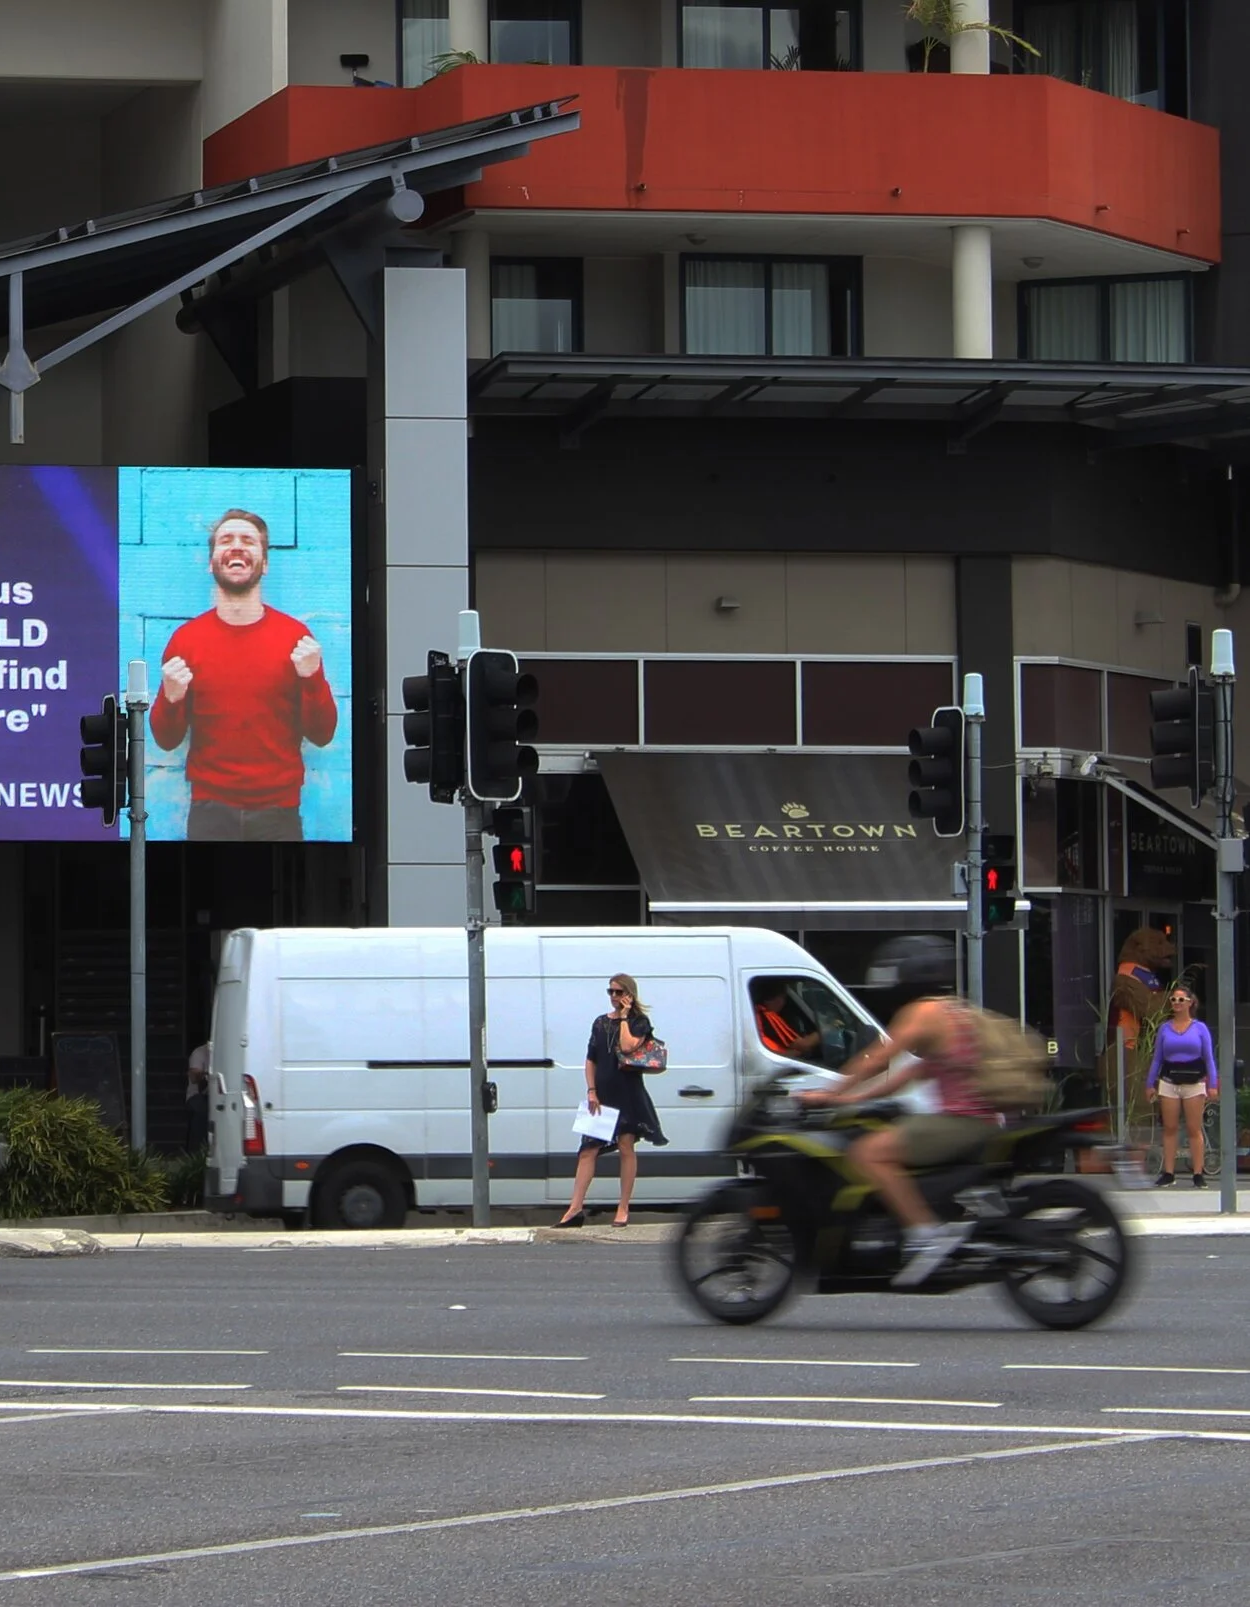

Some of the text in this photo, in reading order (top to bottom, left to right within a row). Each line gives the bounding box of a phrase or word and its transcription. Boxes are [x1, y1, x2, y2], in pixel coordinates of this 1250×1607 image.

[695, 824, 918, 838] BEARTOWN
[748, 845, 881, 853] COFFEE HOUSE
[1130, 832, 1196, 856] BEARTOWN
